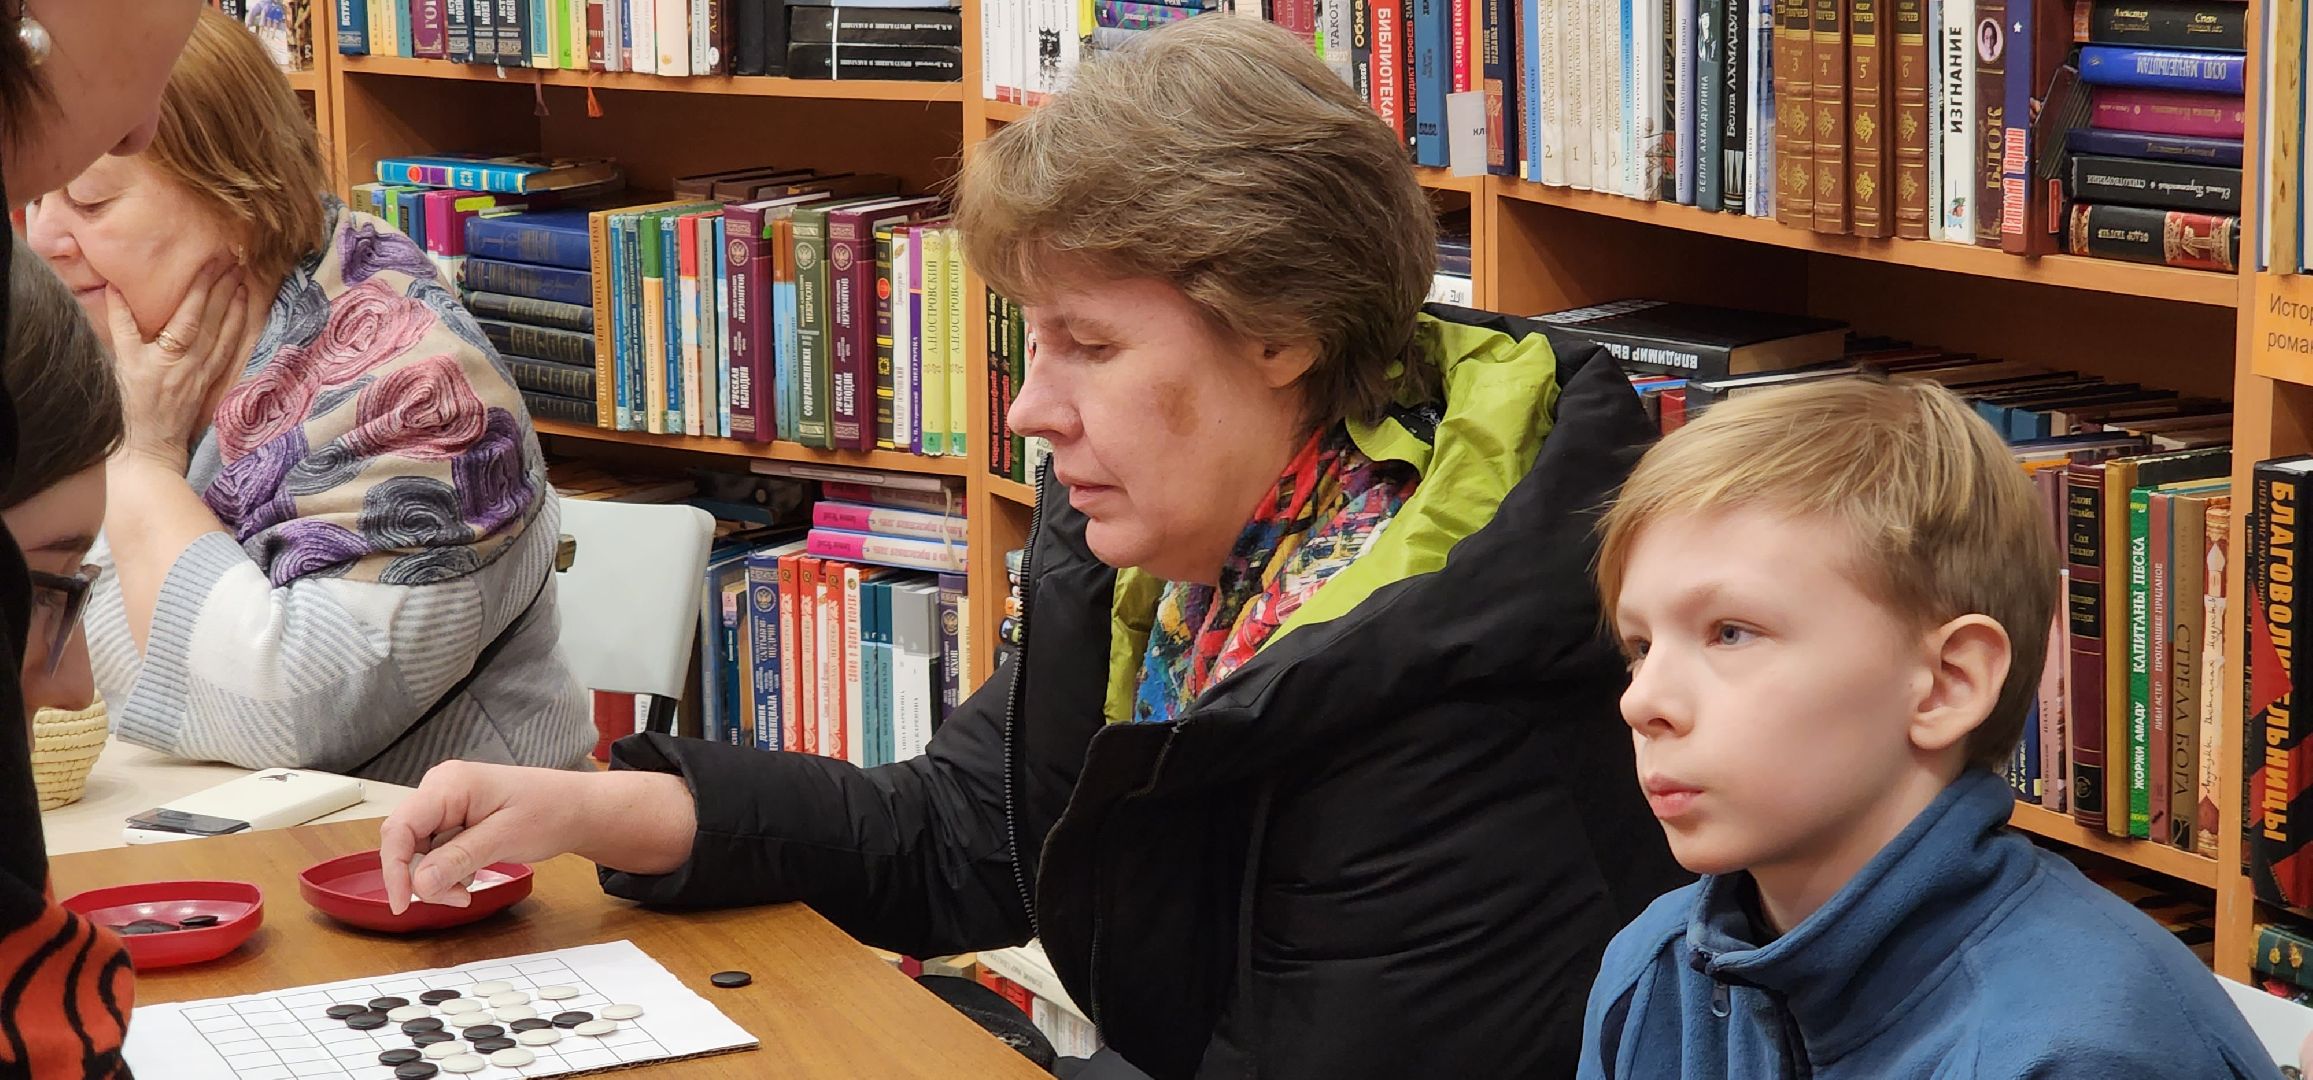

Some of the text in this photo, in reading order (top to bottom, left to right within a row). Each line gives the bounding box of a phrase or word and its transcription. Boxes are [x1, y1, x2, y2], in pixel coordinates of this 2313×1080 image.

[1360, 62, 1368, 102] НСКИЙ
[1378, 8, 1395, 128] БИБЛИОТЕКАР
[1405, 20, 1417, 113] ВЕНЕДИКТ ЕРОФЕЕВ
[1792, 57, 1799, 72] 3
[1821, 62, 1828, 76] 4
[1859, 64, 1867, 79] 5
[1902, 63, 1909, 78] 6
[1949, 26, 1963, 134] ИЗГНАНИЕ
[2136, 57, 2227, 80] ОСИП МАНДЕЛЬШТАМ
[1699, 75, 1709, 193] БЕЛЛА АХМАДУЛИНА
[1726, 93, 1737, 138] Белла
[1985, 105, 2004, 191] БЛОК
[2001, 127, 2028, 235] Василий Теркин
[2087, 174, 2146, 189] СТИХОТВОРЕНИЯ
[591, 218, 601, 276] ГЕРАСИМА
[593, 279, 602, 321] СТАРЦА
[736, 273, 746, 323] ЛЕРМОНТОВ
[804, 281, 814, 323] НЕКРАСОВ
[840, 277, 851, 329] ЛЕРМОНТОВ
[925, 259, 938, 355] А.Н.ОСТРОВСКИЙ
[949, 259, 960, 355] А.Н.ОСТРОВСКИЙ
[989, 314, 997, 353] Ермаков
[1001, 319, 1009, 357] Ермаков
[597, 353, 607, 401] ЛЕСКОВ
[911, 336, 919, 386] СНЕГУРОЧКА
[1631, 346, 1699, 369] ВЛАДИМИР
[730, 367, 740, 406] РУССКАЯ
[739, 365, 750, 409] МЕЛОДИЯ
[802, 347, 814, 417] СОВРЕМЕННИКИ
[834, 372, 843, 413] РУССКАЯ
[842, 371, 854, 416] МЕЛОДИЯ
[990, 370, 999, 433] арифметика
[990, 434, 999, 467] войны
[1003, 439, 1011, 473] войны
[2257, 479, 2267, 611] ДЖОНАТАН ЛИТТЕЛЛ
[950, 650, 959, 678] ЧЕХОВ
[2132, 536, 2147, 790] ЖОРЖИ АМАДУ КАПИТАНЫ ПЕСКА
[2154, 562, 2164, 732] ЛИБИ АСТЕР ПРОПАВШЕЕ ПРИДАНОЕ
[2262, 480, 2295, 843] БЛАГОВОЛИЕЛЬНИЦЫ
[2173, 623, 2192, 725] СТРЕЛА
[757, 703, 768, 743] ДНЕВНИК
[2173, 731, 2191, 797] БОГА
